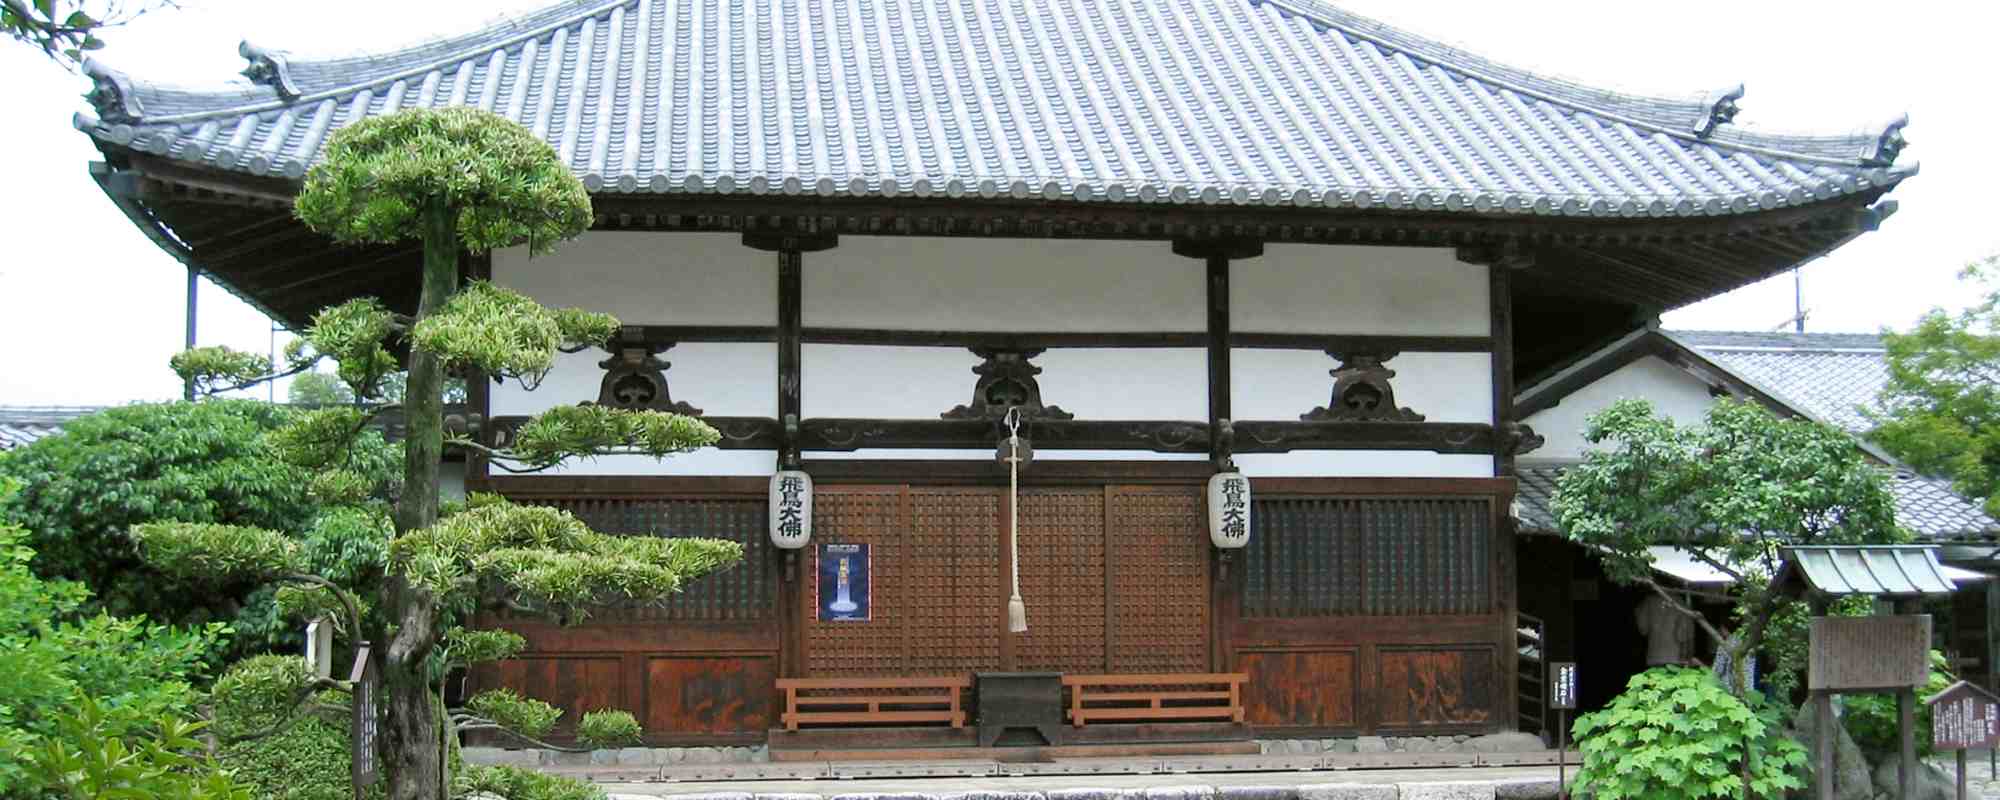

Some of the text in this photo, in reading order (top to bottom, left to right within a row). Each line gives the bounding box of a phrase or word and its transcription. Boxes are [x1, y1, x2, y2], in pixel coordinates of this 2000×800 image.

[778, 476, 804, 538] 飛鳥大佛
[1221, 479, 1246, 539] 飛鳥大佛
